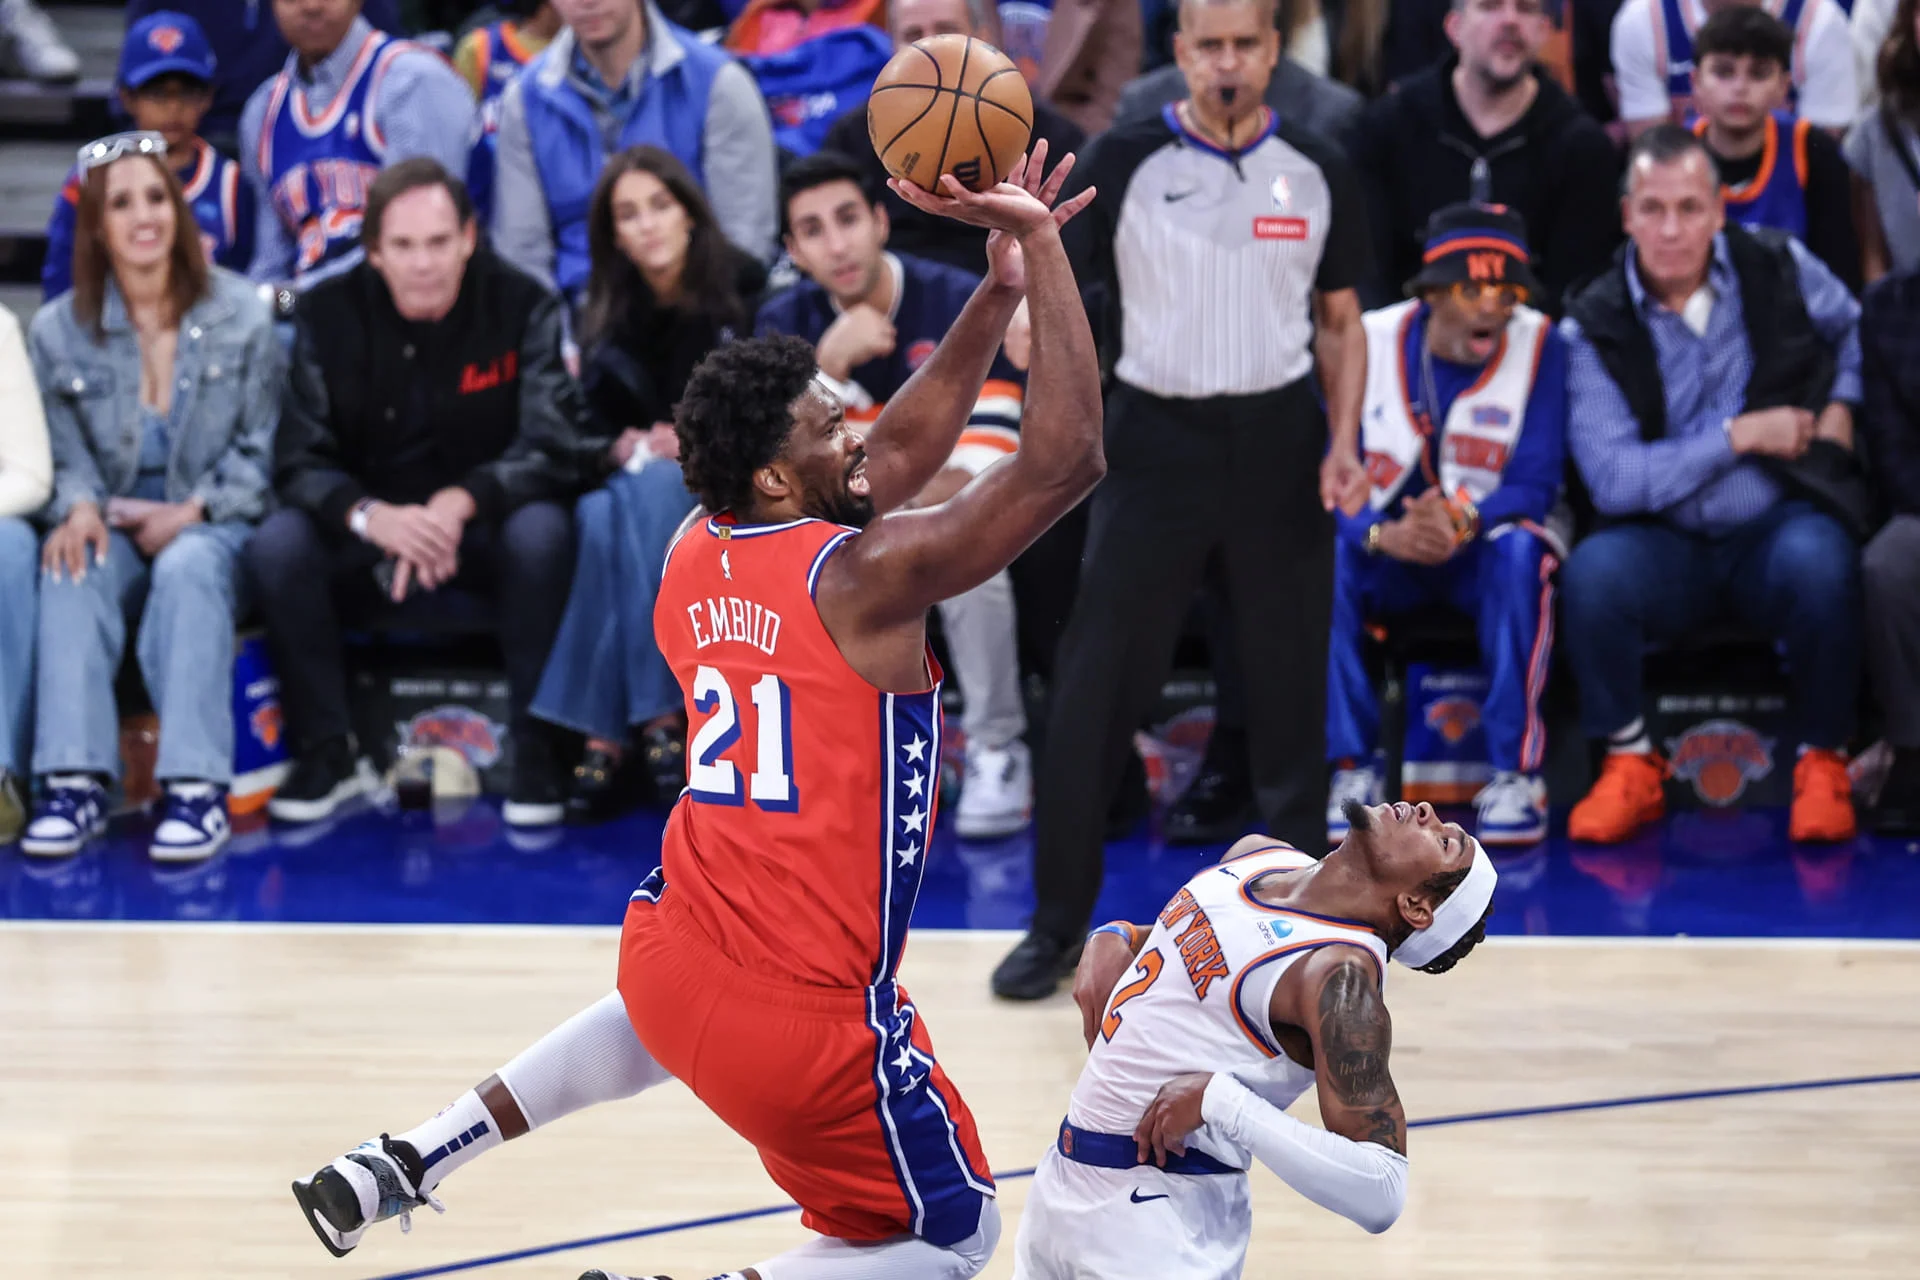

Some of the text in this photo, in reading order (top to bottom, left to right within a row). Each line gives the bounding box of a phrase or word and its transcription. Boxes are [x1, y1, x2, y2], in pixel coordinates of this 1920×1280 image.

[1467, 252, 1506, 280] NY
[686, 596, 781, 656] EMBIID
[689, 664, 799, 814] 21
[1101, 946, 1165, 1045] 2
[1174, 907, 1230, 1002] YORK
